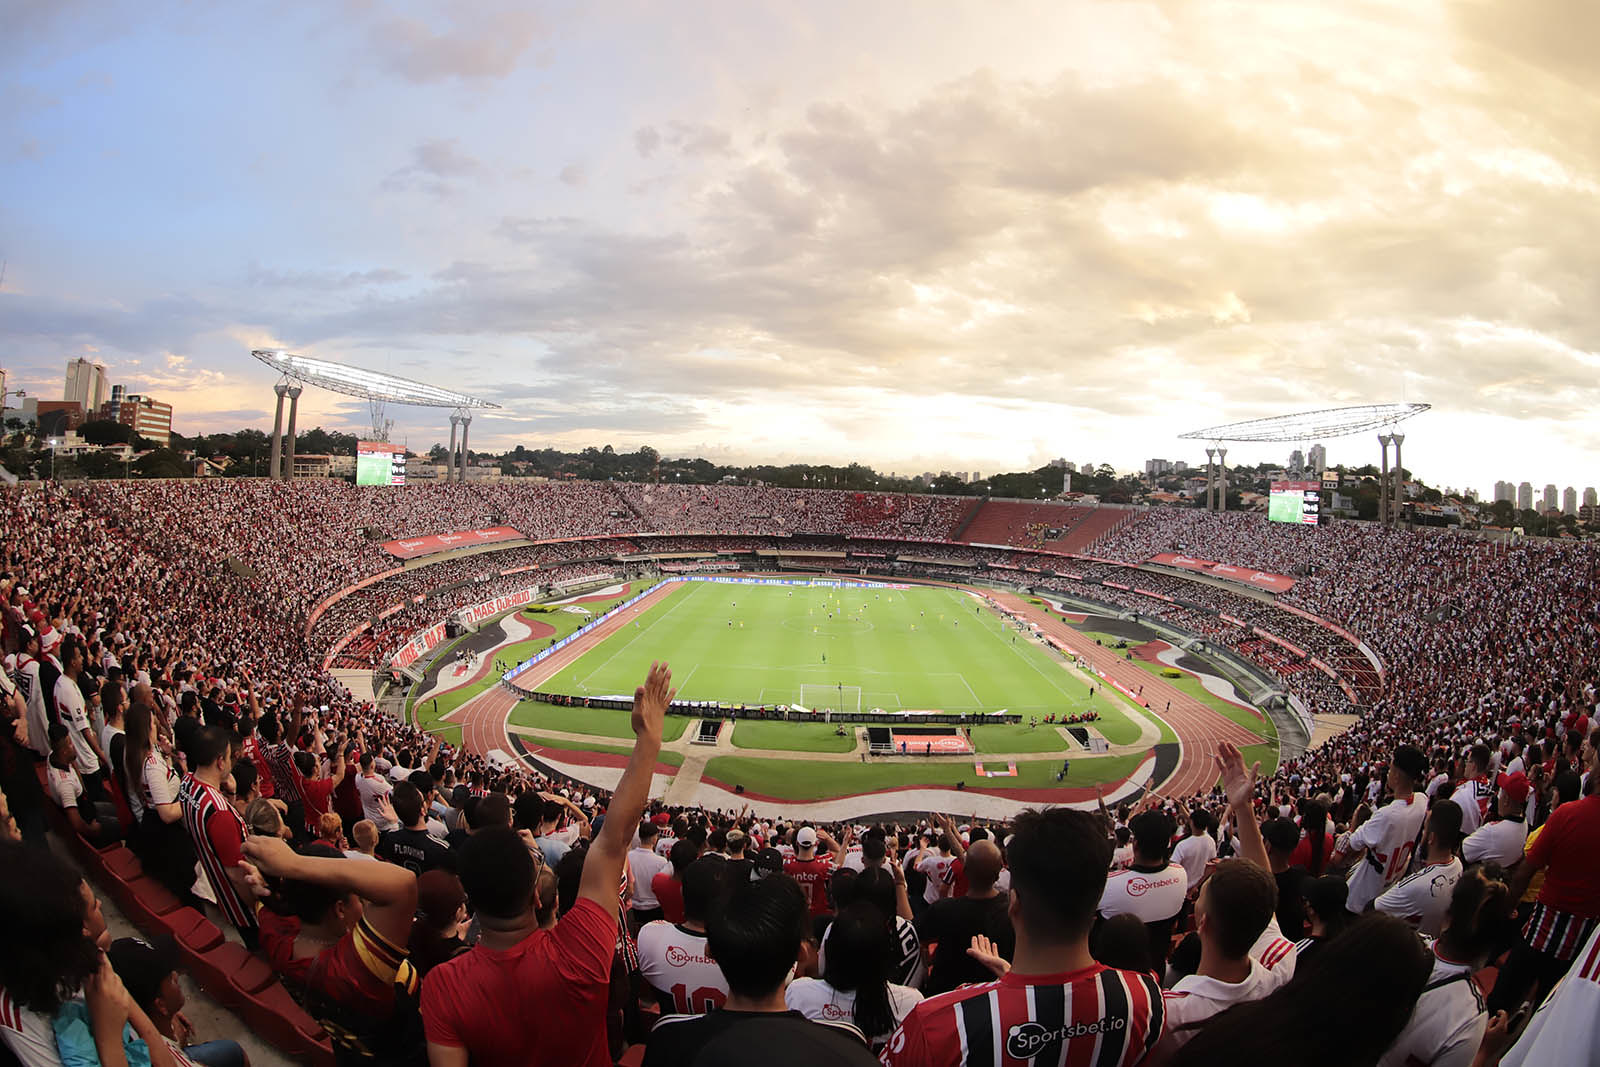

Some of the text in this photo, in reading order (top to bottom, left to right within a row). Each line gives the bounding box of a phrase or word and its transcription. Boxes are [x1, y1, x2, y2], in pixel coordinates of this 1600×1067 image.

[473, 601, 496, 620] MAIS
[496, 590, 530, 612] QUERIDO
[1132, 877, 1180, 892] Sportsbet.io
[1017, 1015, 1125, 1049] Sportsbet.io
